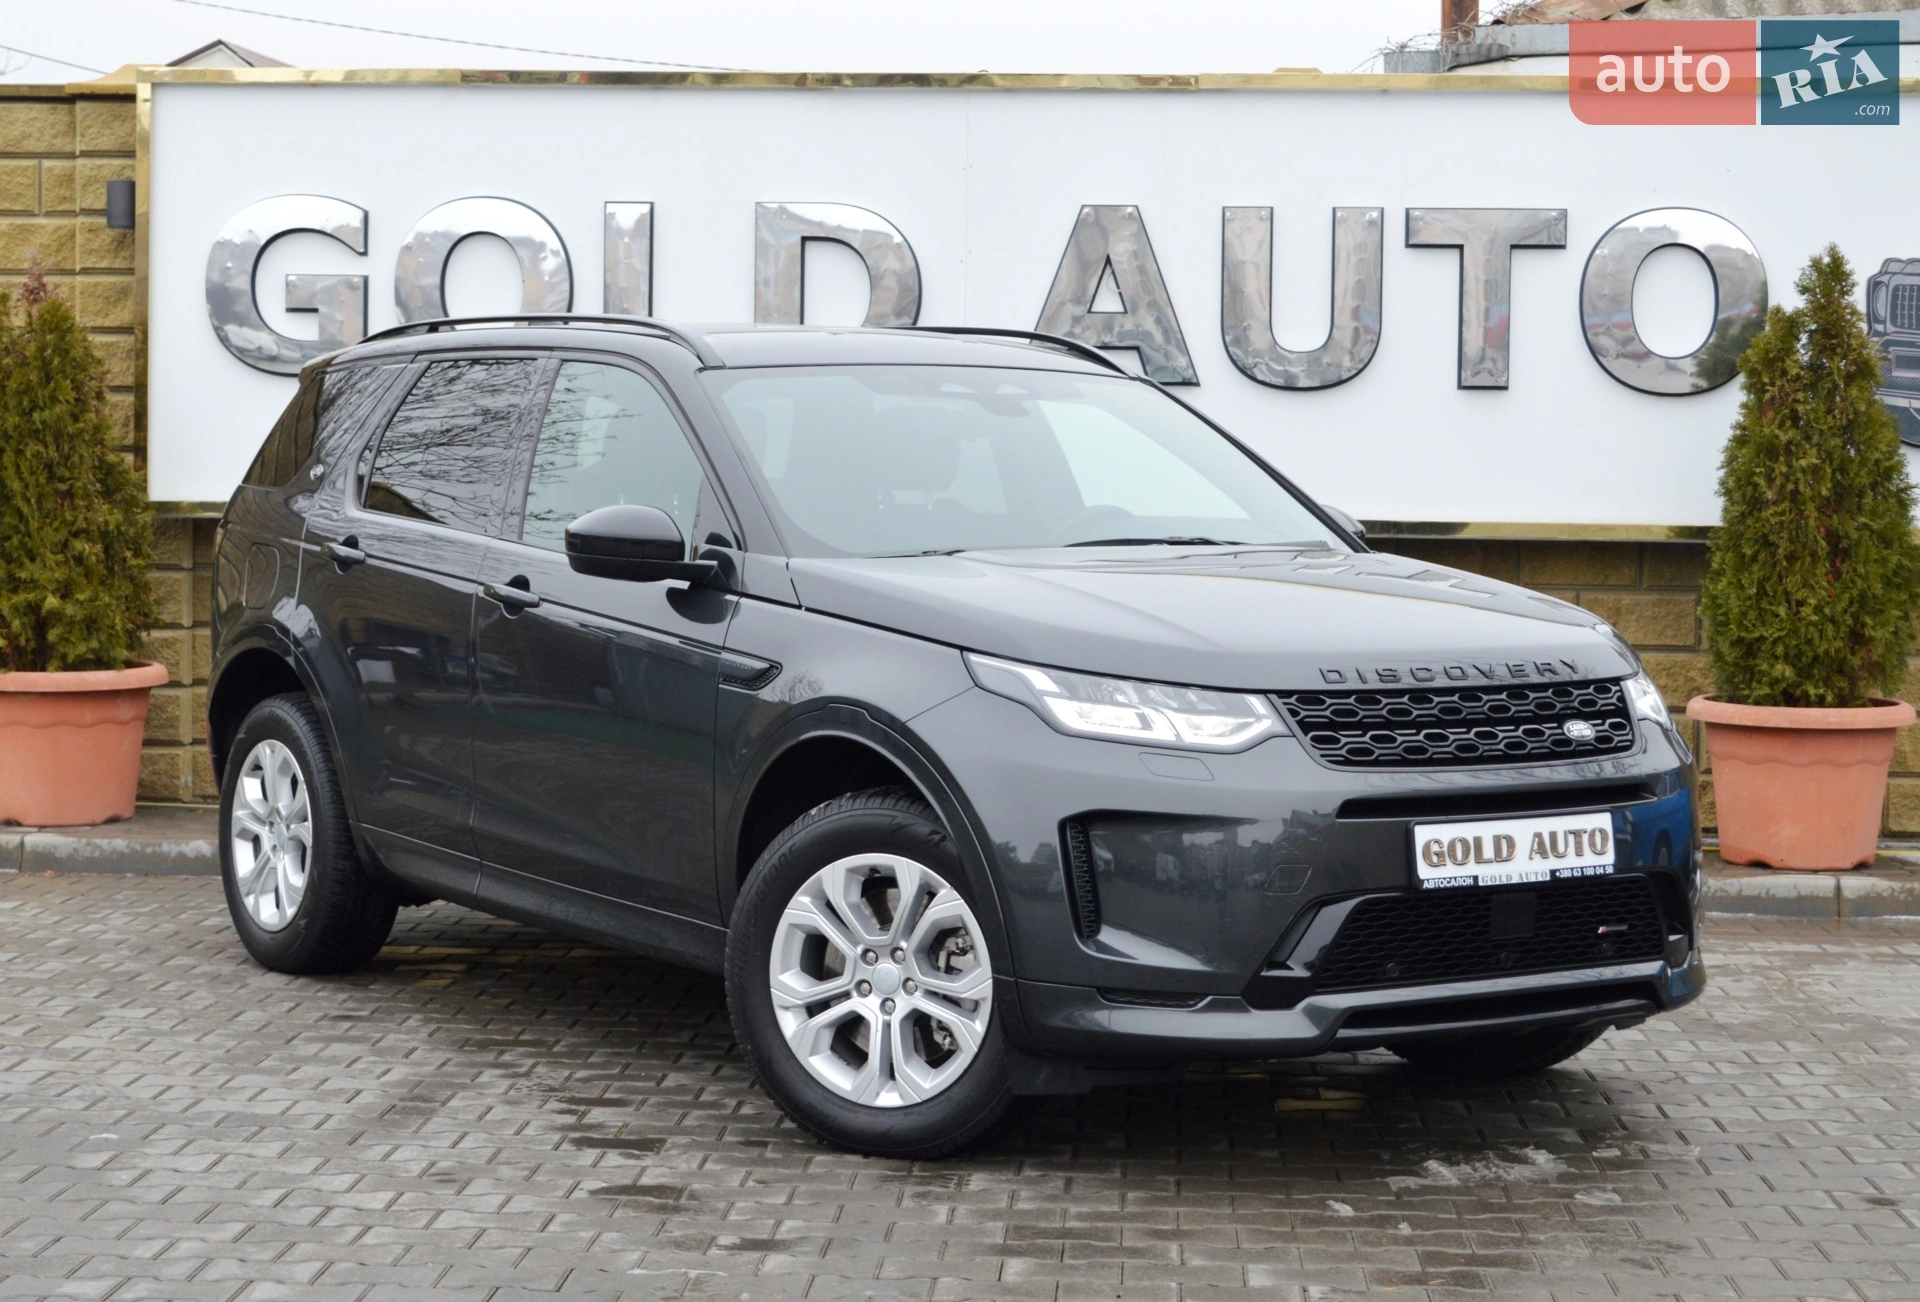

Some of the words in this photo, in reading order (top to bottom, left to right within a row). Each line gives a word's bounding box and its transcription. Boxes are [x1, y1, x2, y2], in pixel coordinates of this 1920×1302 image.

[1035, 204, 1769, 397] AUTO
[1319, 658, 1579, 684] DISCOVERY
[1422, 834, 1517, 867] GOLD
[1529, 827, 1610, 859] AUTO
[1481, 874, 1513, 885] GOLD
[1517, 871, 1548, 882] AUTO
[1555, 869, 1572, 878] +380
[1573, 868, 1582, 877] 63
[1583, 866, 1595, 876] 100
[1596, 866, 1604, 875] 04
[1605, 865, 1614, 874] 50
[1423, 876, 1474, 889] АВТОСАЛОН
